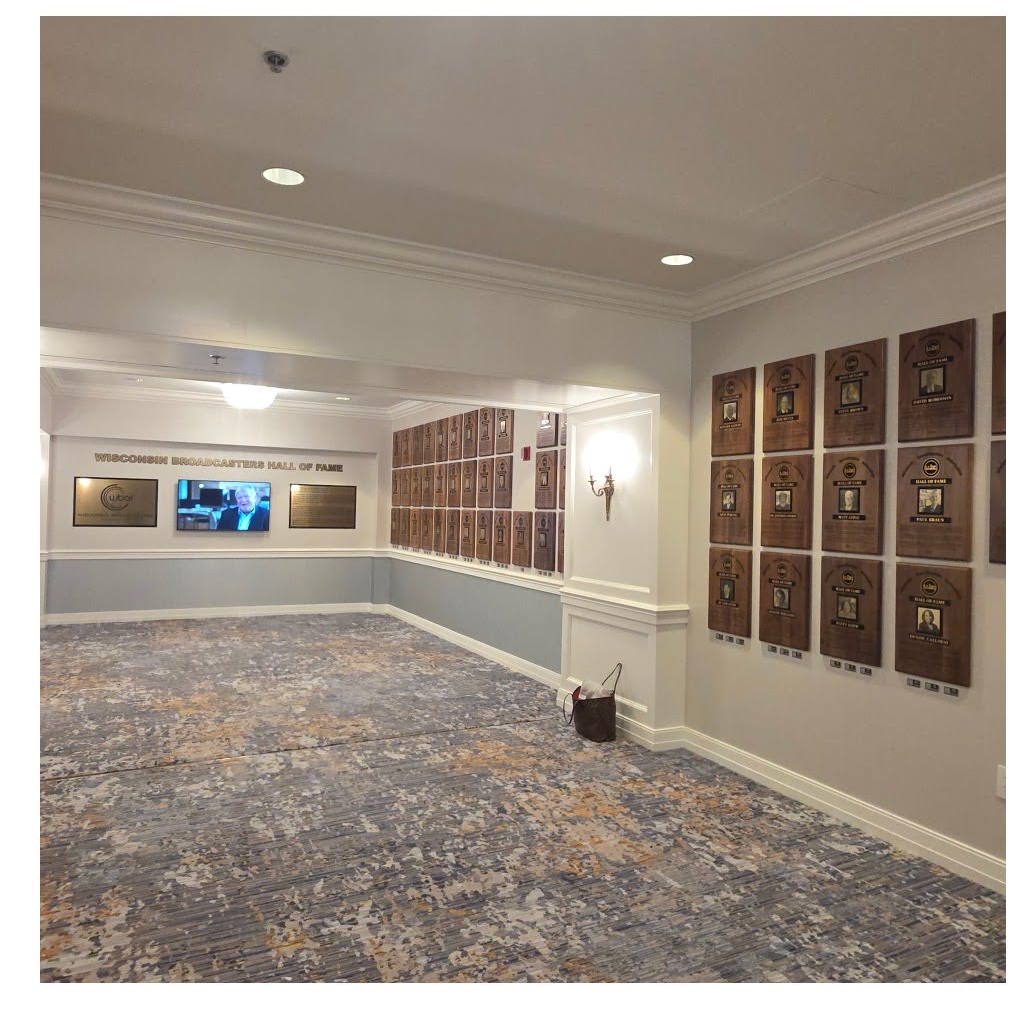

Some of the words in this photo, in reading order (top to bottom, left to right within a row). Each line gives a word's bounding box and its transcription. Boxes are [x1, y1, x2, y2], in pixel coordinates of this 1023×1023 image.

[95, 453, 168, 464] WISCONSIN
[172, 456, 264, 469] BROADCASTERS
[268, 460, 296, 470] HALL
[299, 463, 313, 471] OF
[316, 463, 343, 472] FAME
